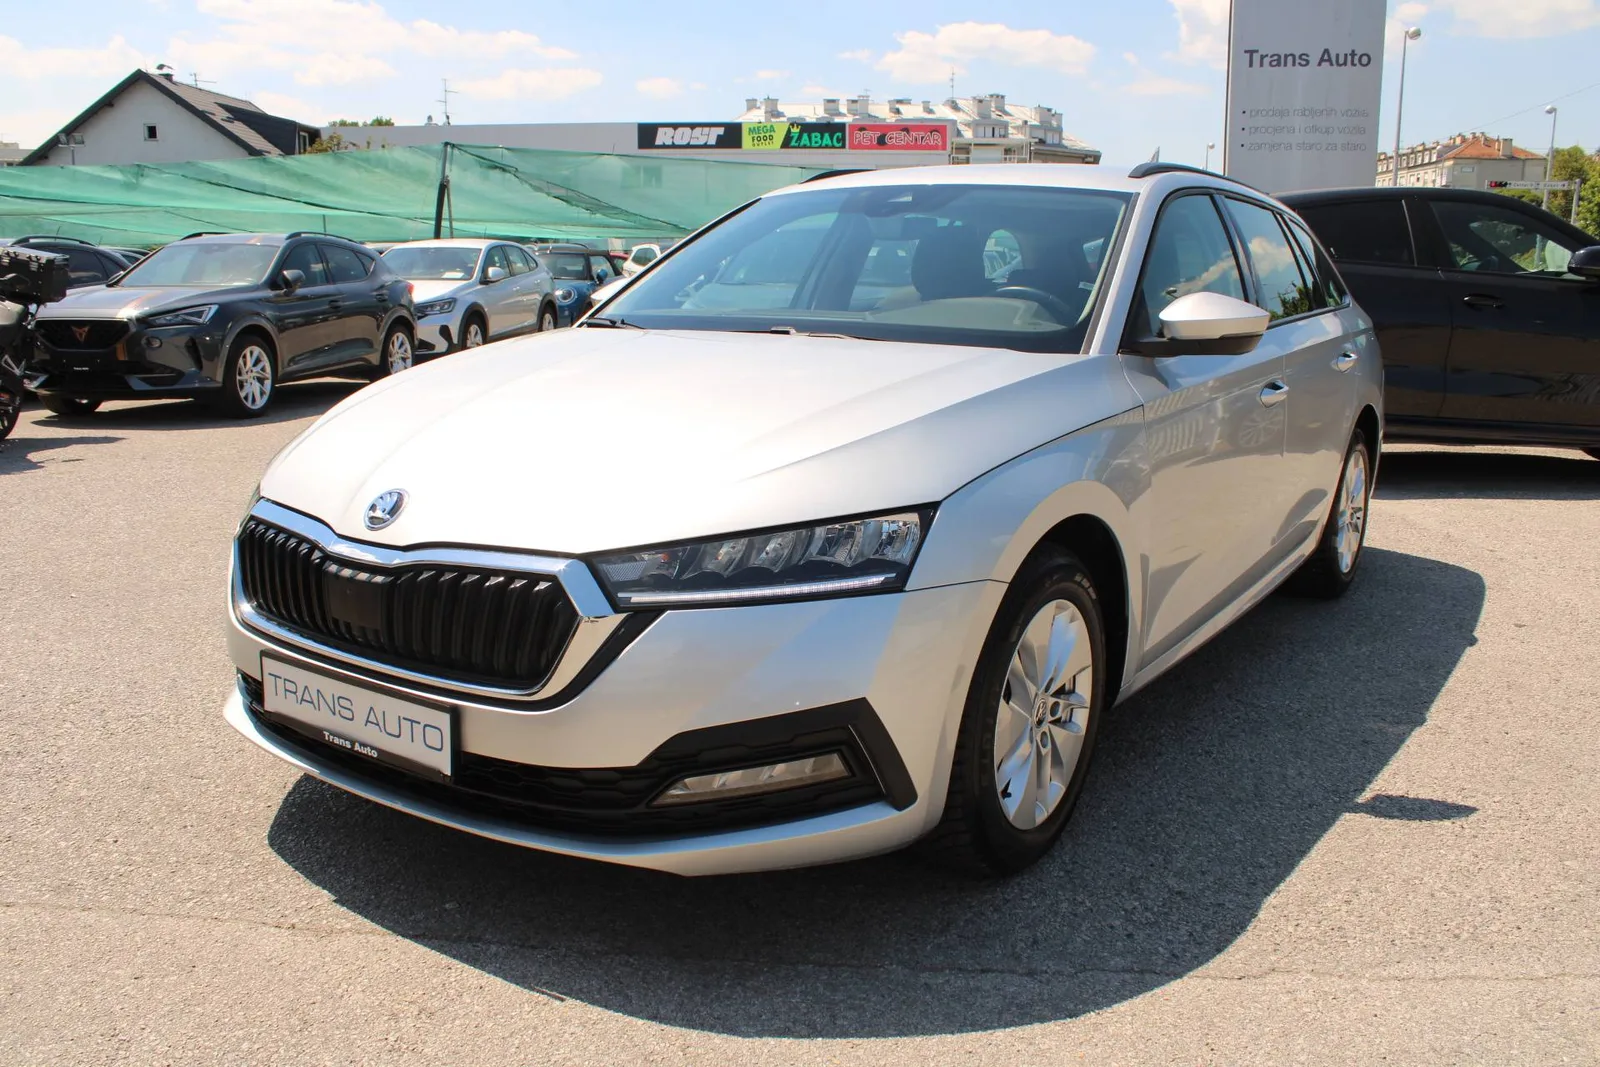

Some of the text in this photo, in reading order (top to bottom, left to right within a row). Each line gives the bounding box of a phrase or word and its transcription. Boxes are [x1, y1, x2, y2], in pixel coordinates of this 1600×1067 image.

[1244, 48, 1372, 68] Trans Auto
[1250, 107, 1290, 119] prodaja
[748, 124, 776, 136] MEGA
[1337, 124, 1366, 135] vozila
[751, 134, 774, 143] FOOD
[853, 130, 941, 145] PET CENTAR
[267, 672, 444, 752] TRANS AUTO
[323, 730, 378, 758] Trans Auto
